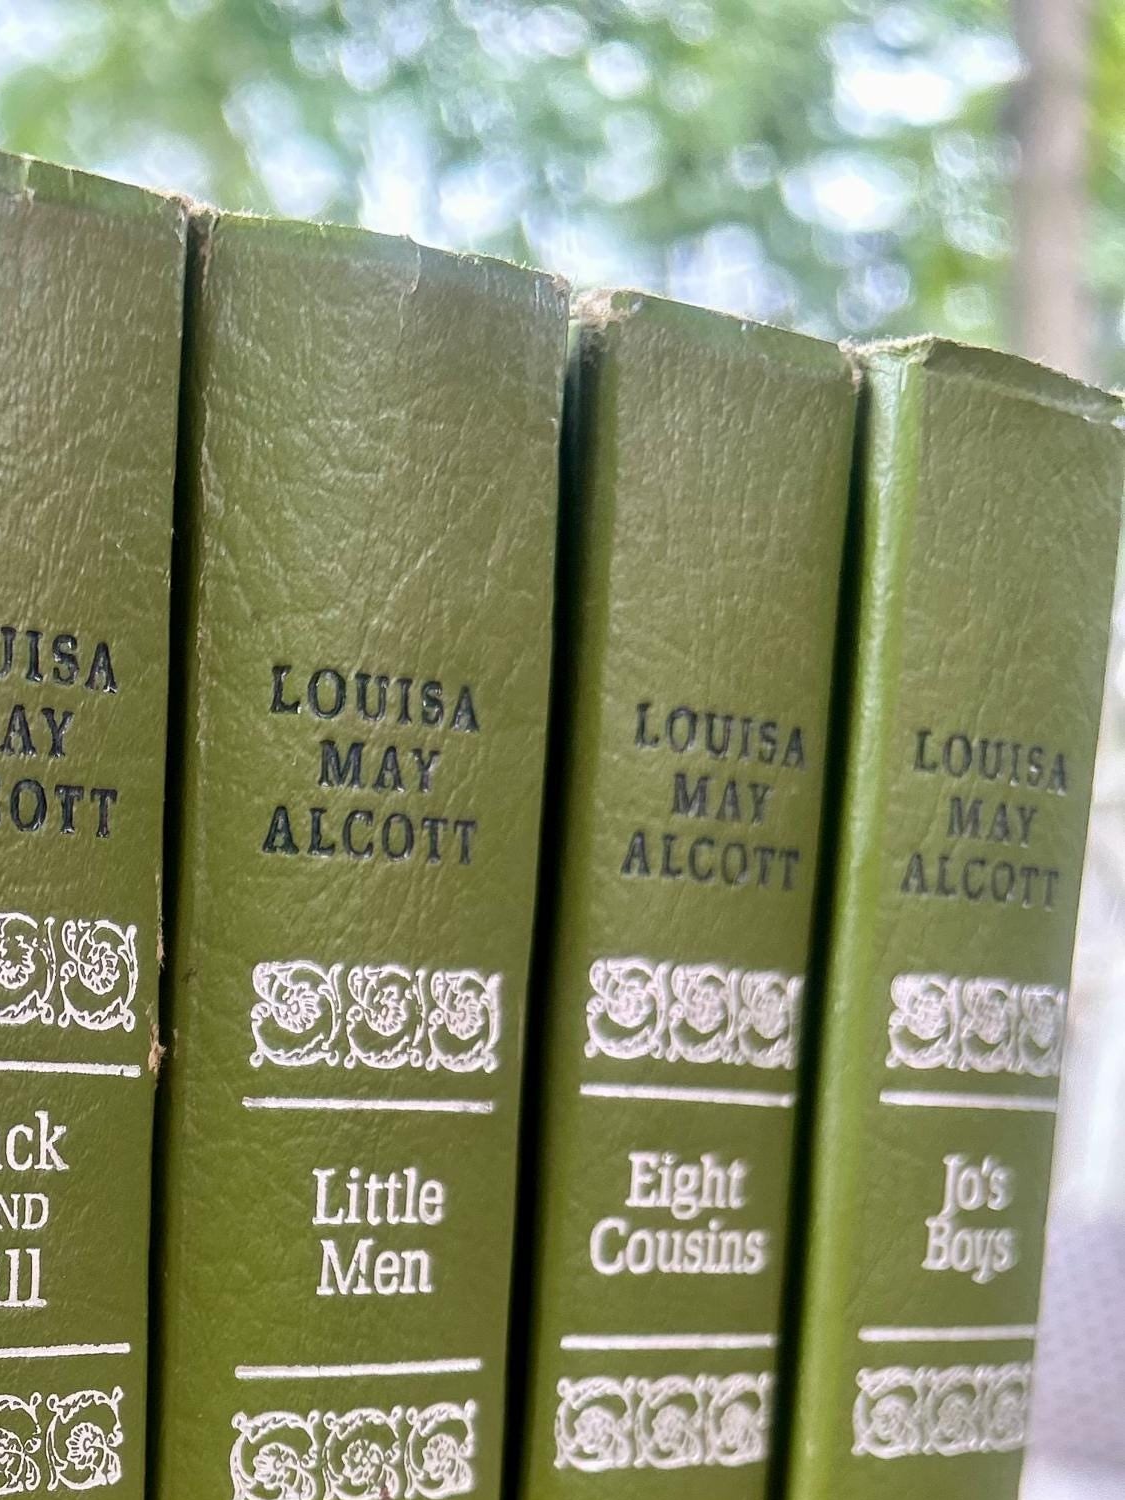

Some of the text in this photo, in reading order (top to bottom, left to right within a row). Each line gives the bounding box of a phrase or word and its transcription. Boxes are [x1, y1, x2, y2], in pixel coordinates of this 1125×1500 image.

[271, 664, 480, 734] LOUISA
[634, 702, 807, 768] LOUISA
[913, 728, 1070, 798] LOUISA
[317, 739, 442, 795] MAY
[672, 772, 774, 828] MAY
[947, 795, 1040, 849] MAY
[262, 805, 478, 867] ALCOTT
[620, 830, 801, 891] ALCOTT
[899, 852, 1062, 911] ALCOTT
[312, 1167, 444, 1227] Little
[625, 1151, 749, 1221] Eight
[939, 1153, 1015, 1216] Jo's
[316, 1240, 433, 1297] Men
[589, 1220, 767, 1276] Cousins
[922, 1217, 1018, 1285] Boys
